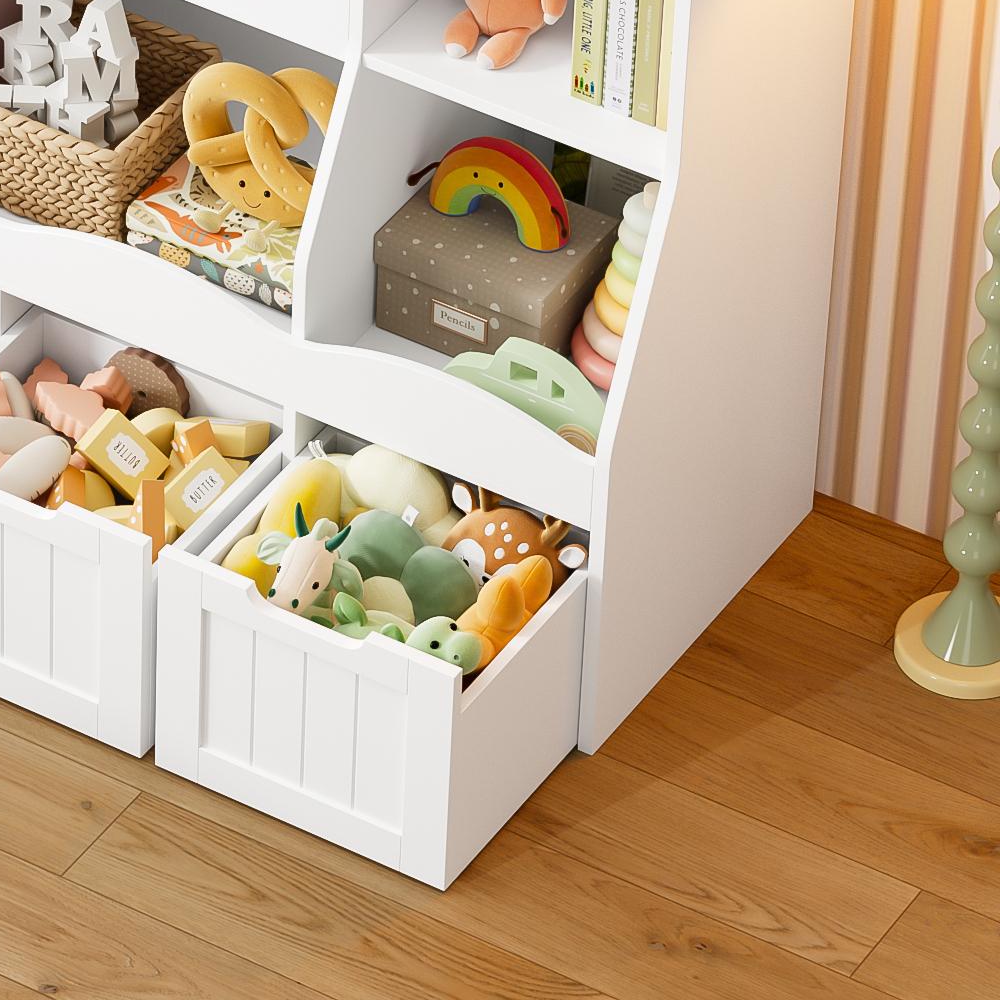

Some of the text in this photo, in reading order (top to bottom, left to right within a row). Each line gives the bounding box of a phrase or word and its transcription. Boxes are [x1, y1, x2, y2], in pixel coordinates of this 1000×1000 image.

[616, 7, 626, 61] CHOCOLATE
[440, 309, 477, 332] Pencils
[112, 440, 142, 470] BUTTER
[190, 475, 219, 504] BUTTER
